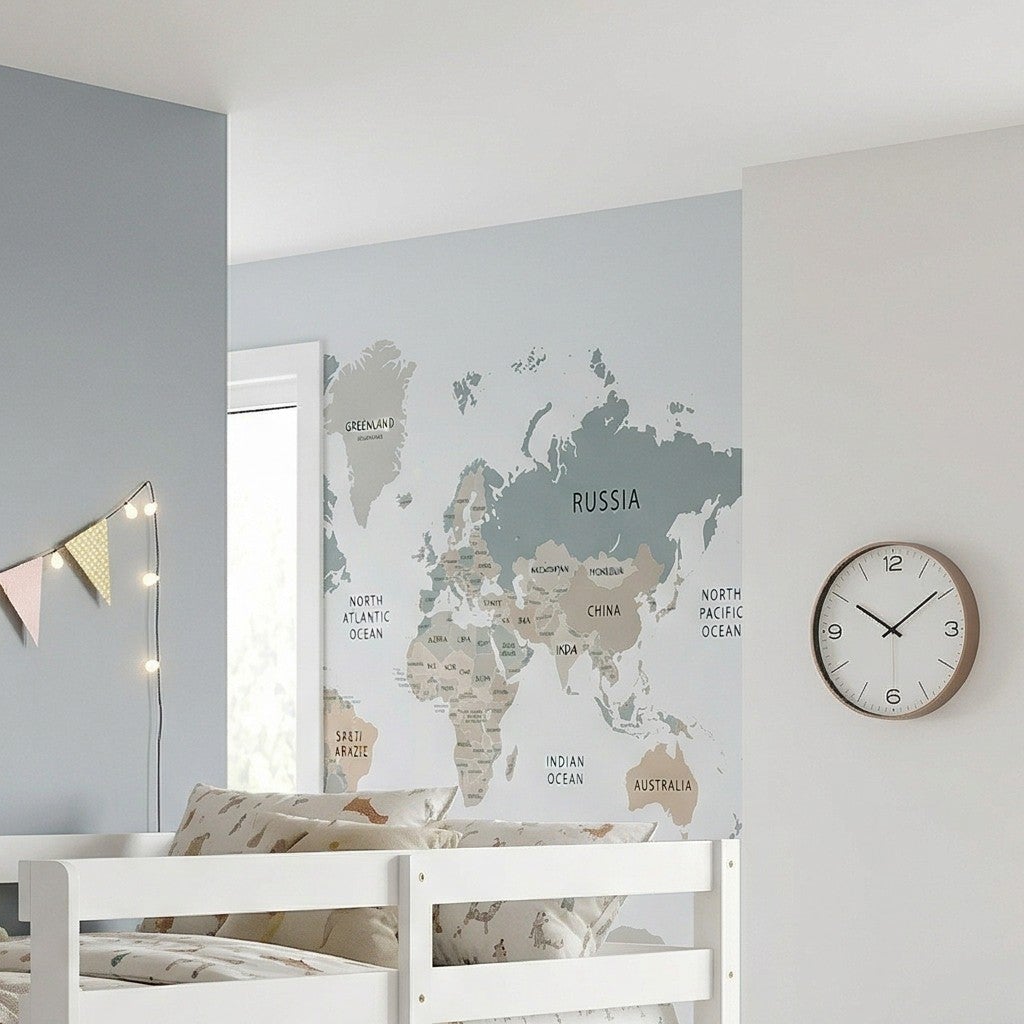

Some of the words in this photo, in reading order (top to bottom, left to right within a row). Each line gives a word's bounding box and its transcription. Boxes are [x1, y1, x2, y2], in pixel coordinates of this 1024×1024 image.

[573, 488, 640, 513] RUSSIA
[883, 555, 903, 572] 12
[349, 594, 383, 607] NORTH
[701, 587, 741, 601] NORTH
[342, 610, 391, 624] ATLANTIC
[587, 604, 621, 617] CHINA
[699, 605, 744, 620] PACIFIC
[349, 627, 383, 640] OCEAN
[701, 624, 742, 638] OCEAN
[828, 624, 843, 640] 9
[944, 620, 959, 637] 3
[886, 689, 901, 705] 6
[546, 755, 585, 768] INDIAN
[547, 772, 584, 785] OCEAN
[633, 779, 692, 792] AUSTRALIA
